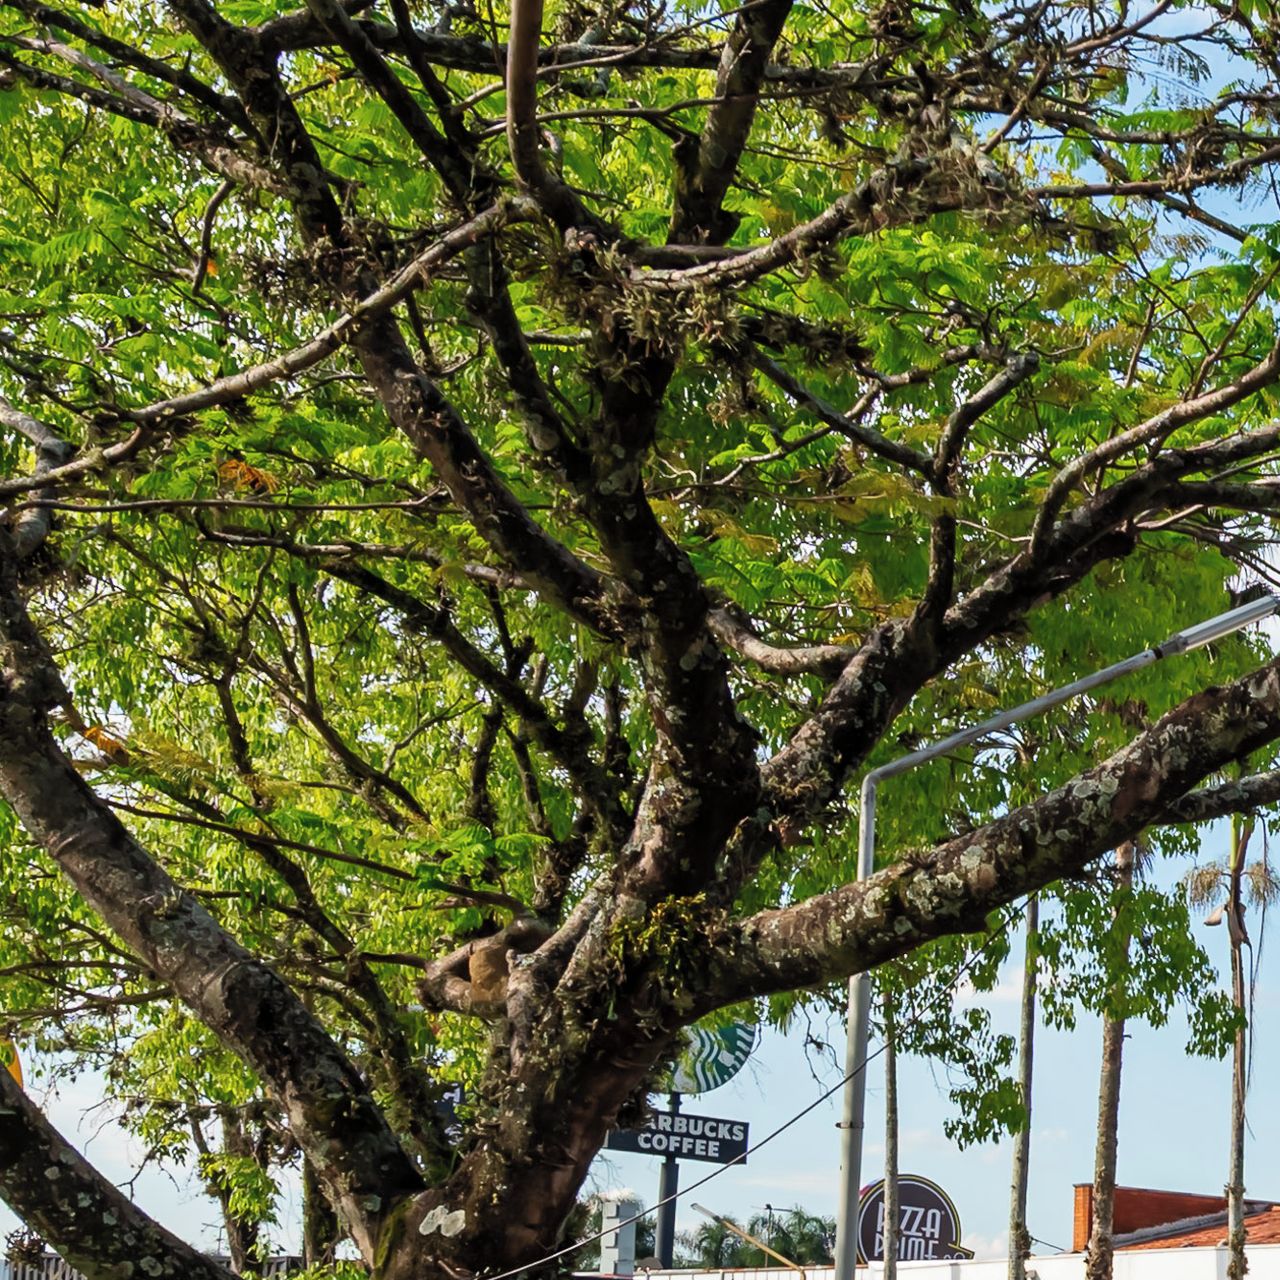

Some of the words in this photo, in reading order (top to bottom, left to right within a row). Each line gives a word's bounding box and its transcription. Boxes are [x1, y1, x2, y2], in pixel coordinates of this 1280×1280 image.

[637, 1132, 720, 1157] COFFEE
[876, 1201, 941, 1239] PZZA
[874, 1233, 939, 1260] PIME
